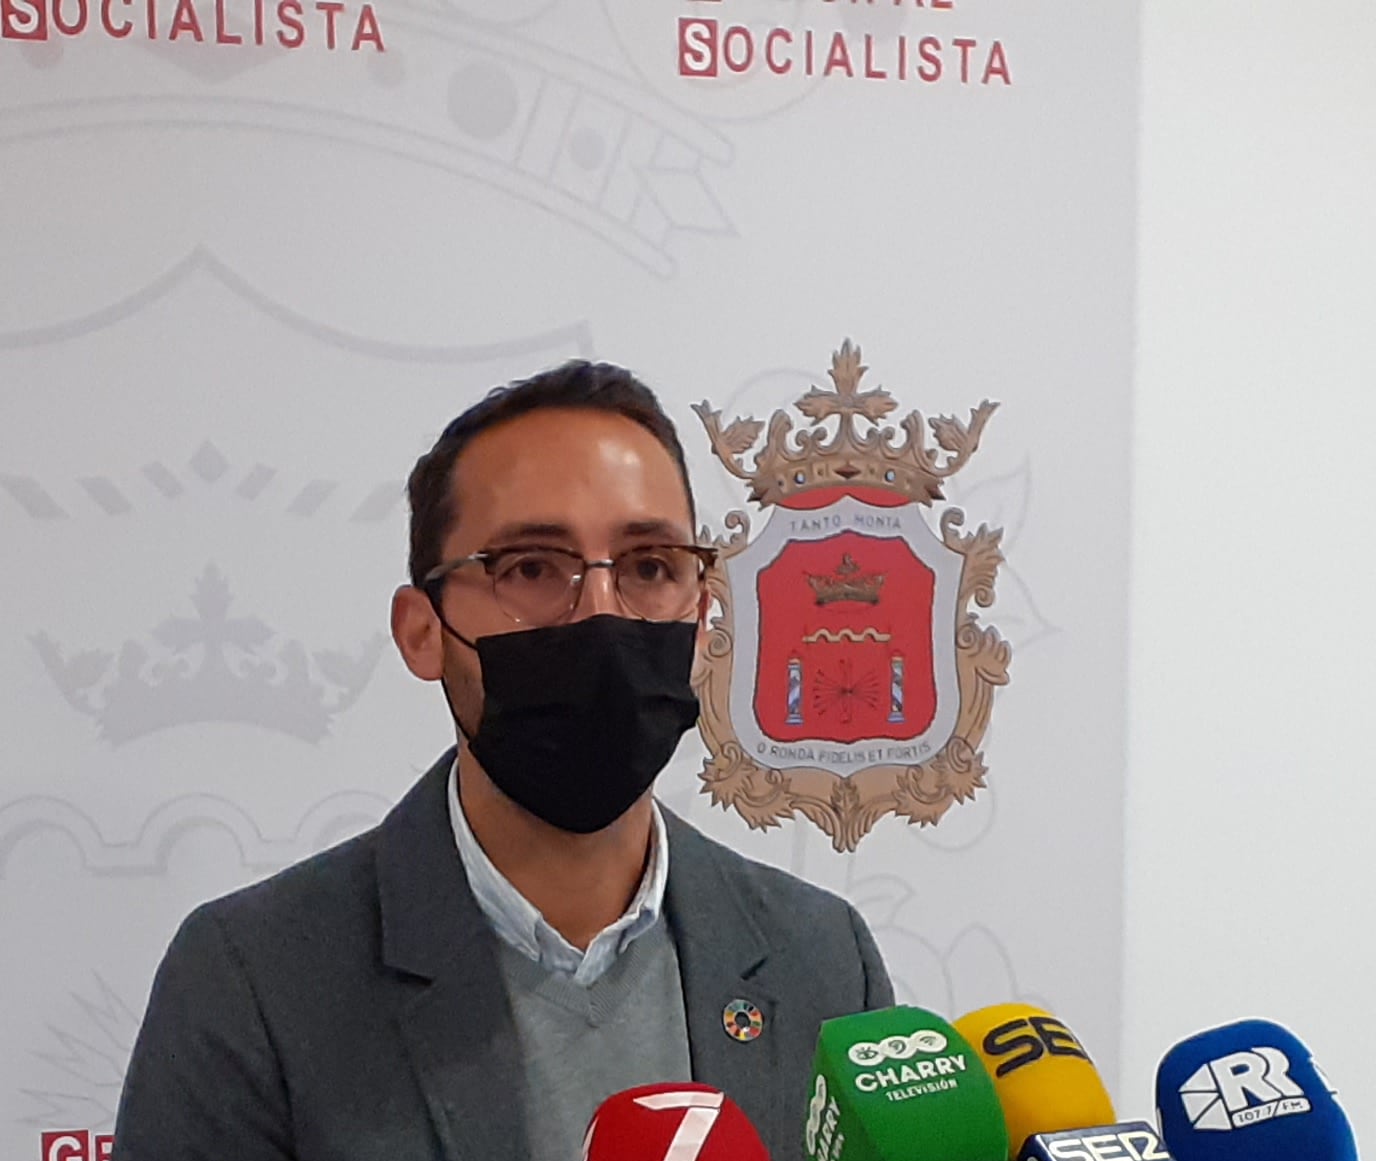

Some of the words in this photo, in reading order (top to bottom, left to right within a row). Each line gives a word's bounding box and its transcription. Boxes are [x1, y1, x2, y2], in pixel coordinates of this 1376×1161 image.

[2, 0, 385, 53] SOCIALISTA
[678, 18, 1012, 86] SOCIALISTA
[789, 514, 842, 532] TANTO
[854, 1054, 967, 1092] CHARRY
[982, 1016, 1093, 1079] SE
